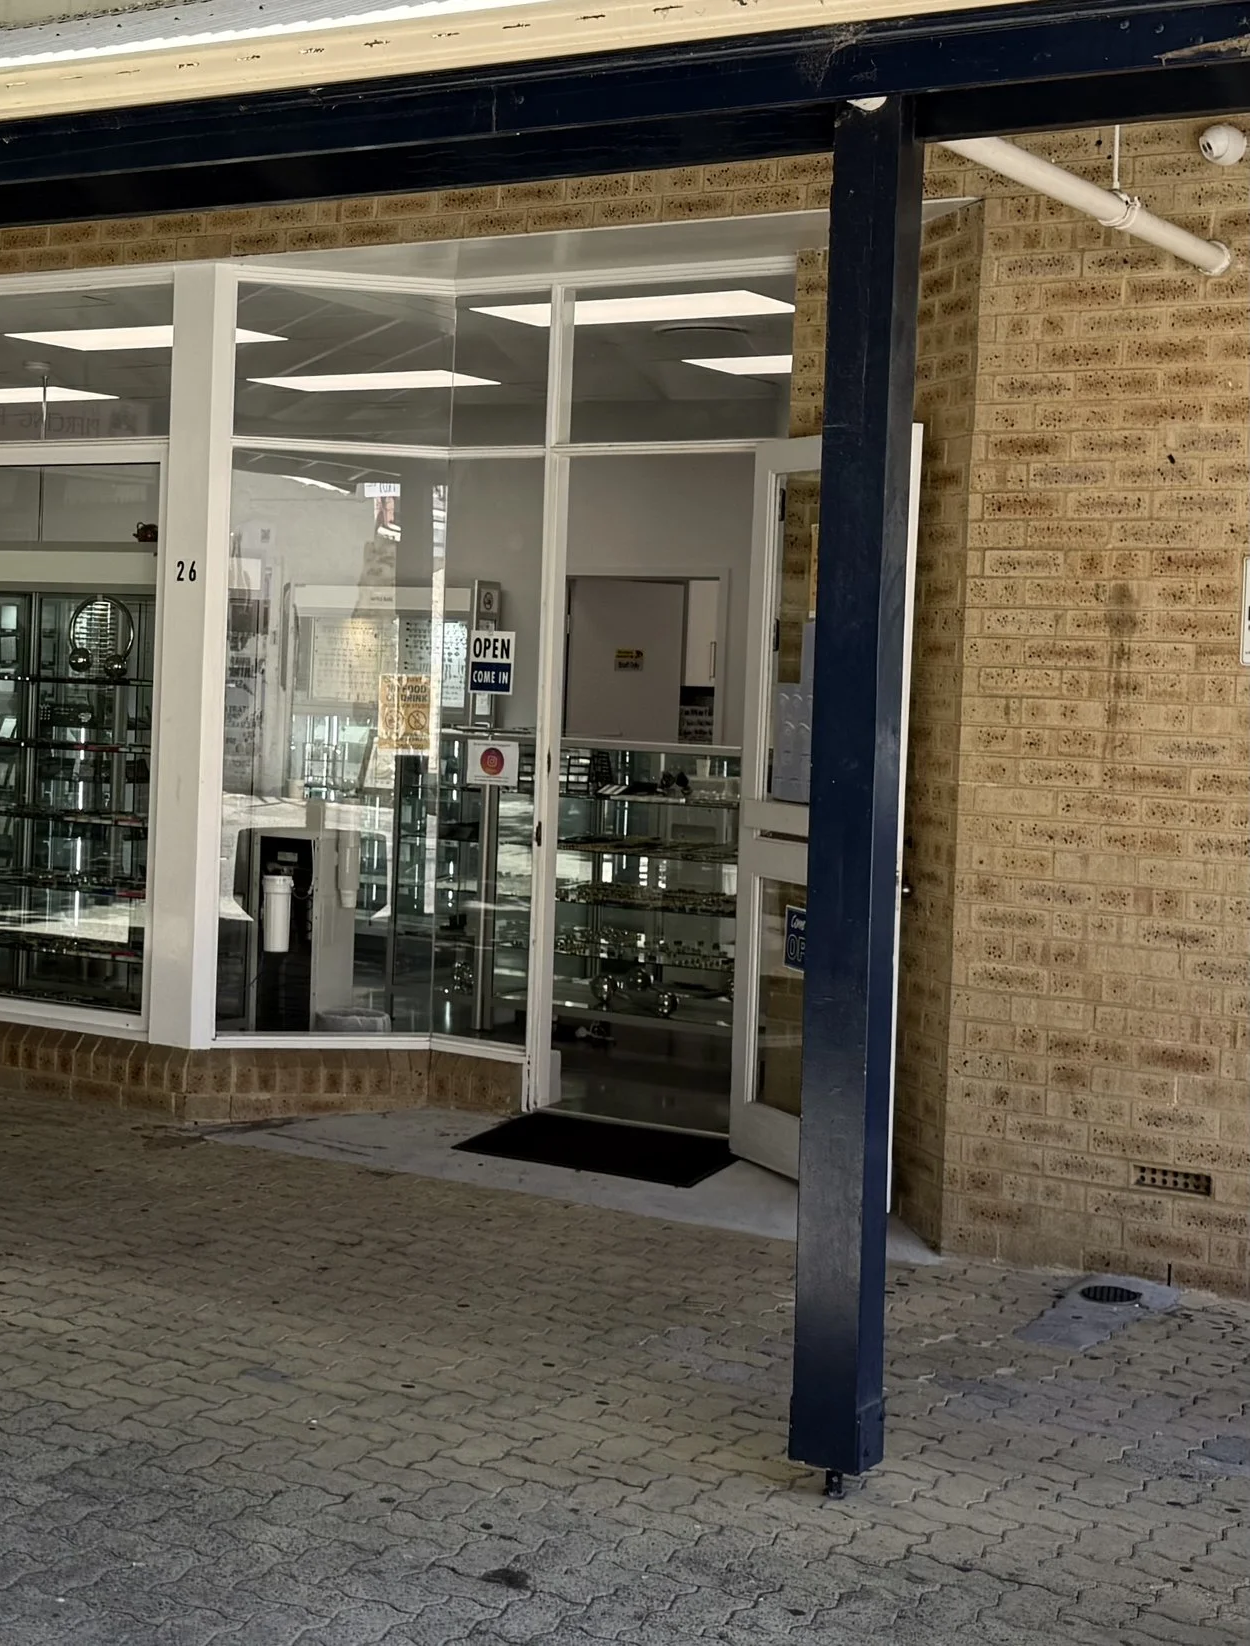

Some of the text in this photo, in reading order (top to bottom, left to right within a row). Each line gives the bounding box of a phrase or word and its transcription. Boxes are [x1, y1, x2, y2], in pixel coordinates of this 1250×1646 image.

[176, 560, 197, 582] 26
[473, 637, 511, 660] OPEN
[472, 670, 509, 685] COME IN
[402, 684, 427, 694] FOOD
[400, 694, 428, 703] DRINK
[787, 933, 806, 962] OP
